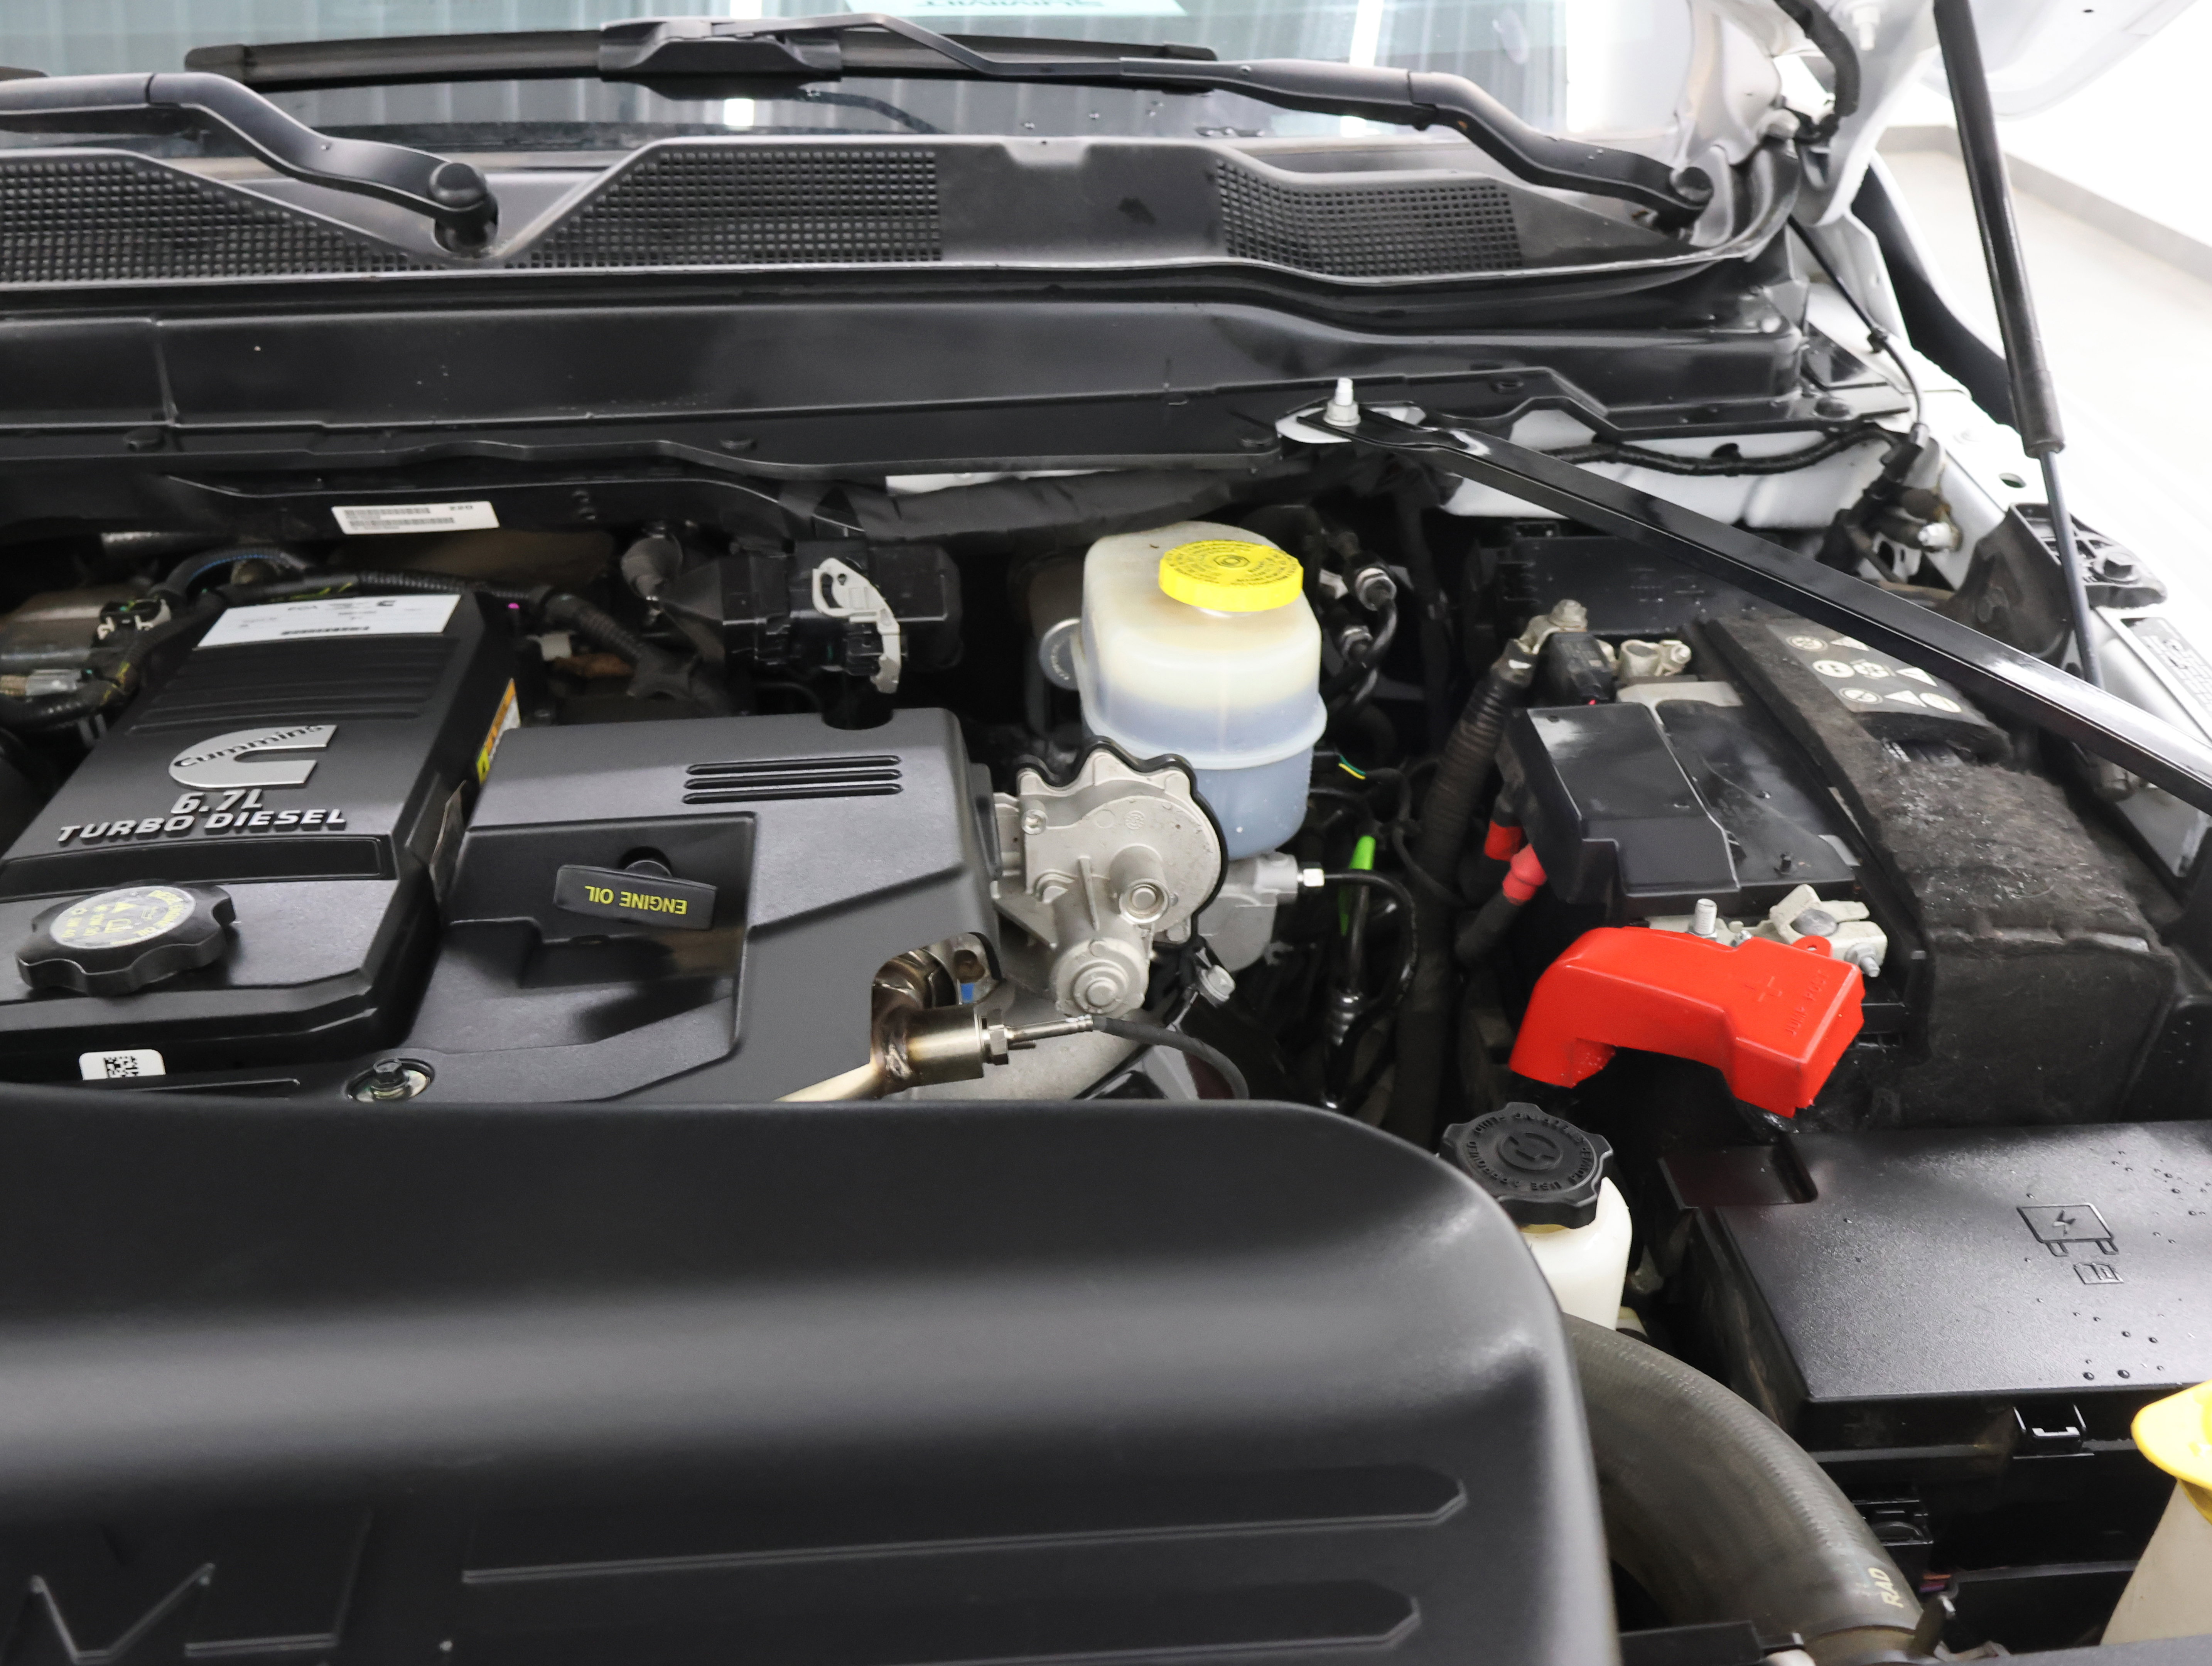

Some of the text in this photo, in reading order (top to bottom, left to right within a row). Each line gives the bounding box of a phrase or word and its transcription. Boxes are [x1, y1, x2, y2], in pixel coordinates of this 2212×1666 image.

[173, 724, 323, 767] Cummins
[170, 788, 263, 815] 6.7L
[57, 808, 346, 842] TURBO DIESEL
[584, 885, 688, 915] ENGINE OIL
[1867, 1567, 1904, 1608] RAD
